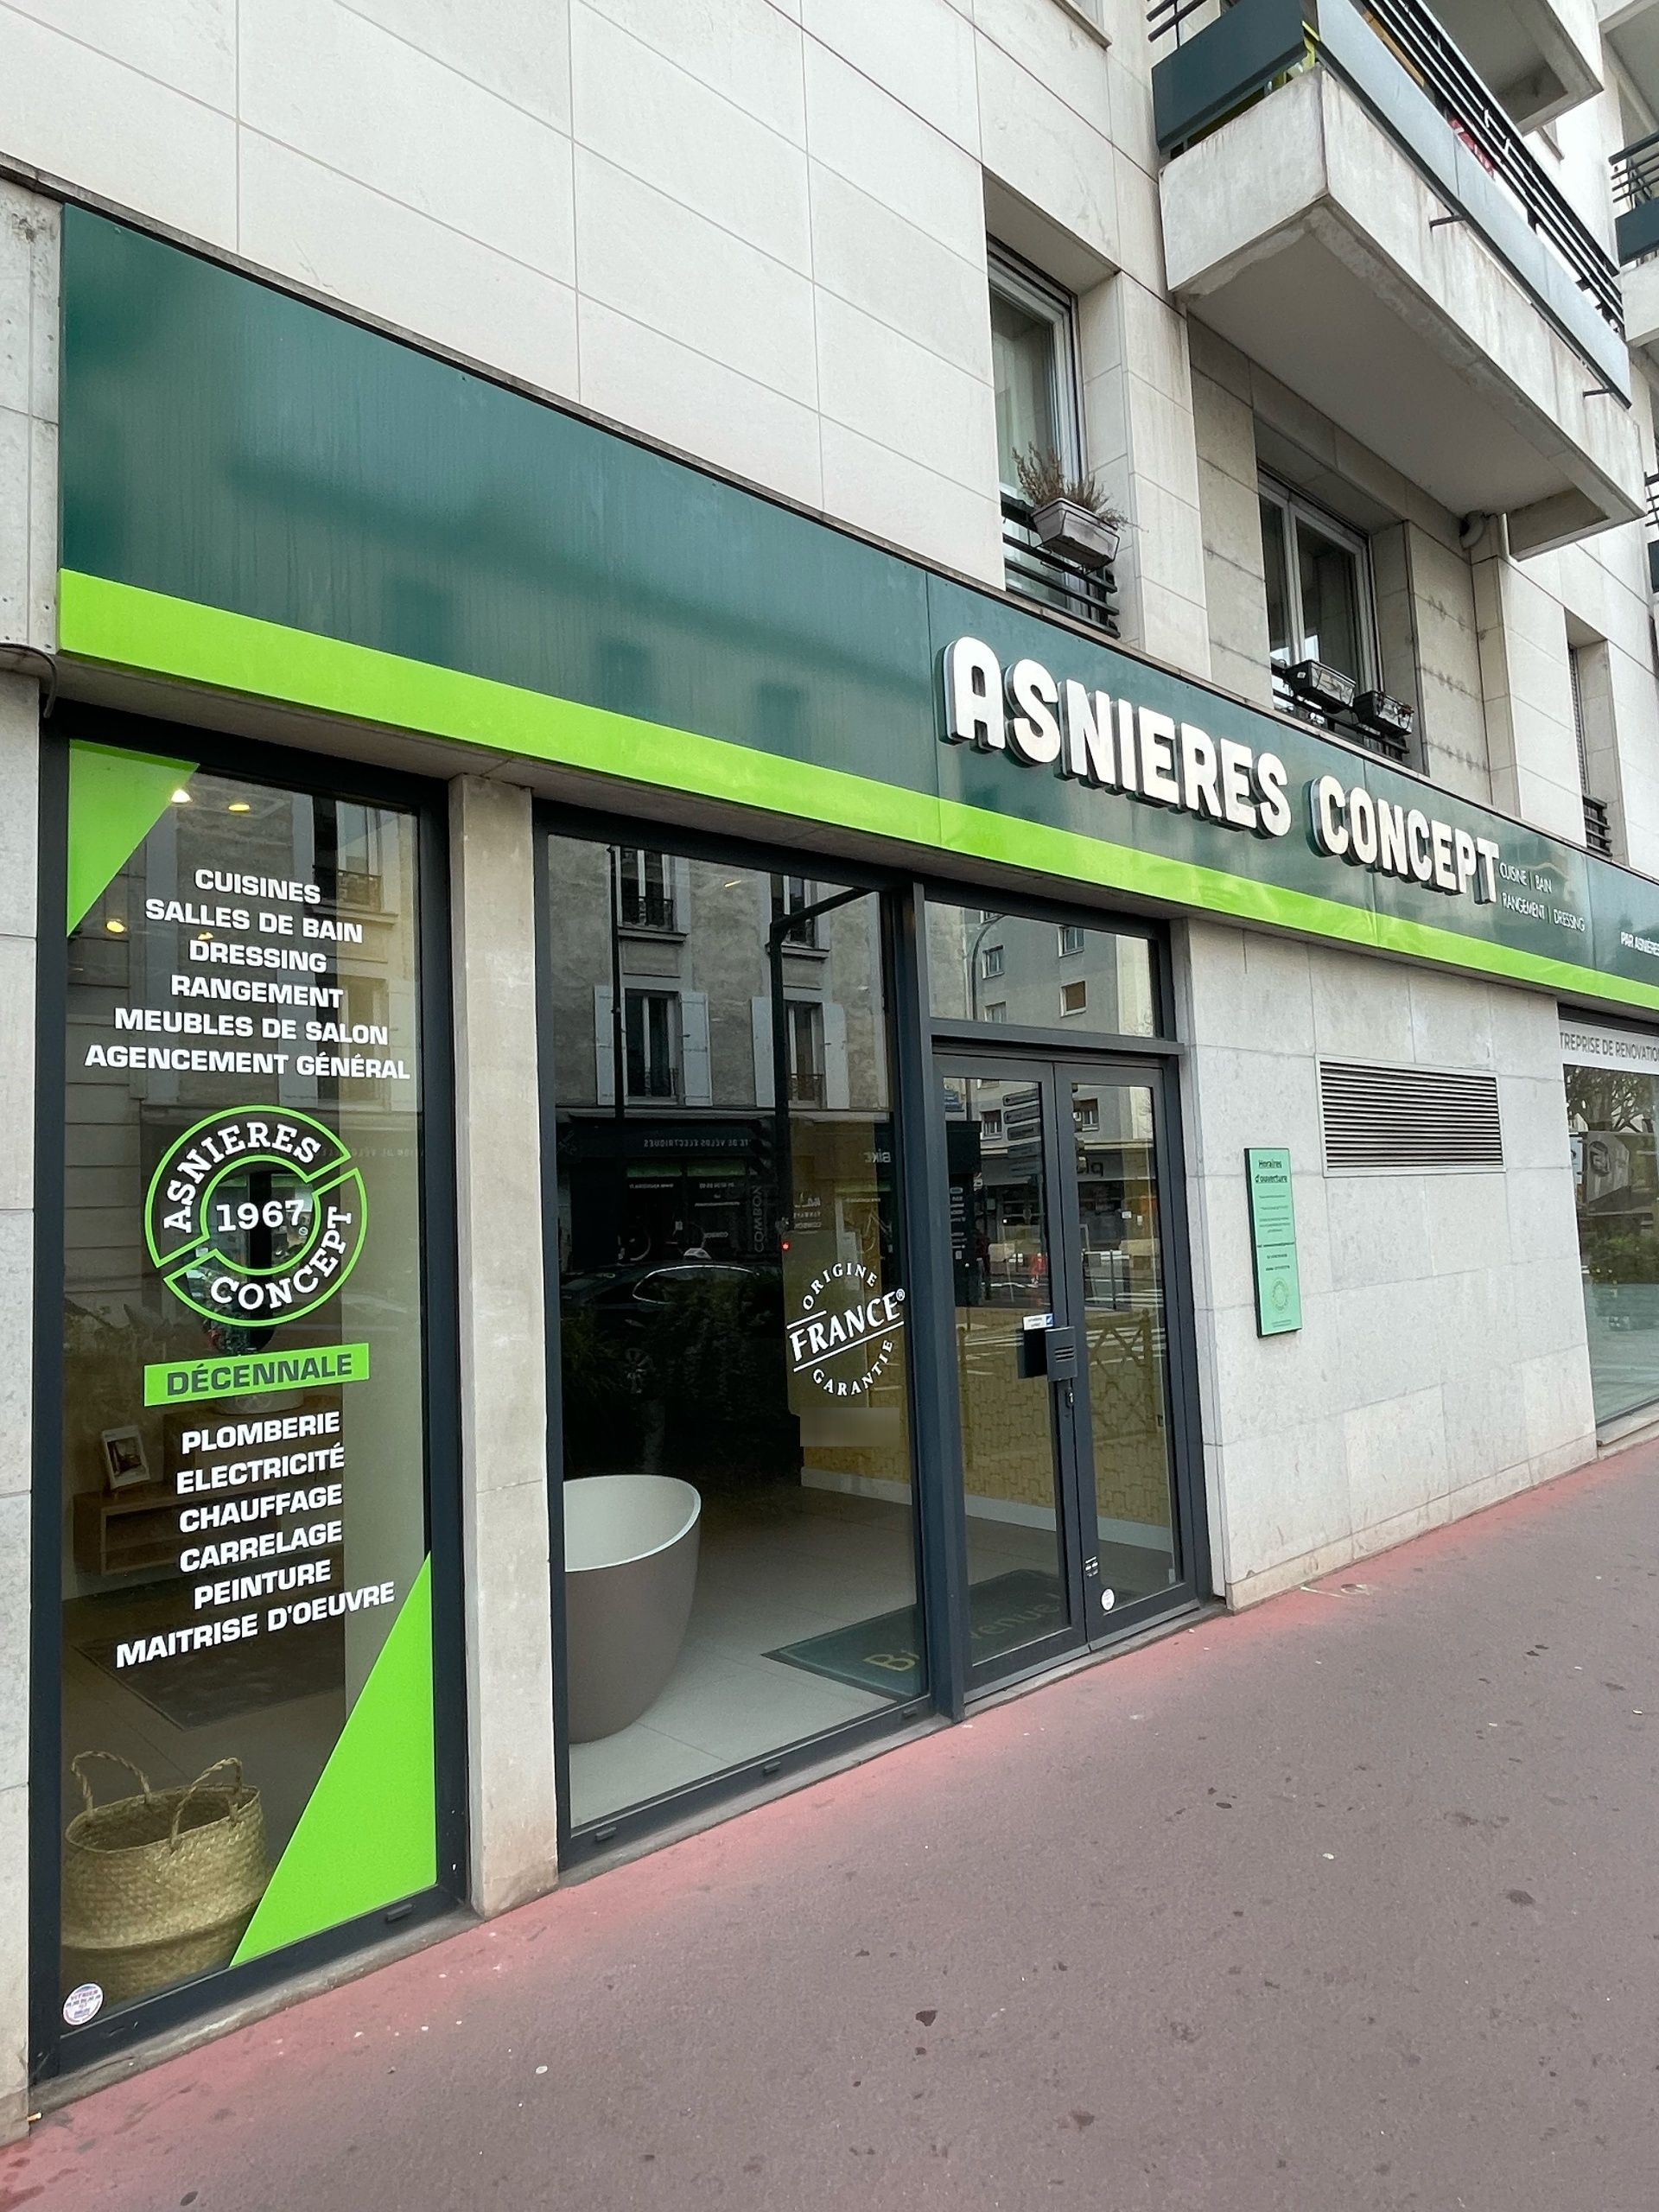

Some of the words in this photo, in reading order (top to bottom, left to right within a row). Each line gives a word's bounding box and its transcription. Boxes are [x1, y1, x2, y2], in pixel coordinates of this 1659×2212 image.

[945, 636, 1293, 837] ASNIERES
[1312, 775, 1500, 904] CONCEPT
[194, 868, 321, 905] CUISINES
[1499, 862, 1528, 886] CUISINE
[1535, 874, 1553, 894] BAIN
[145, 899, 251, 931] SALLES
[258, 912, 294, 936] DE
[302, 917, 364, 944] BAIN
[1502, 892, 1545, 920] RANGEMENT
[1554, 908, 1586, 931] DRESSING
[189, 939, 328, 974] DRESSING
[171, 974, 344, 1008] RANGEMENT
[114, 1007, 254, 1038] MEUBLES
[262, 1018, 297, 1040] DE
[305, 1020, 389, 1046] SALON
[1602, 1039, 1614, 1056] DE
[85, 1045, 289, 1076] AGENCEMENT
[296, 1051, 411, 1080] GÉNÉRAL
[163, 1122, 321, 1234] ASNIERES
[1258, 1159, 1282, 1169] Horaires
[215, 1199, 305, 1232] 1967
[210, 1206, 353, 1311] CONCEPT
[802, 1262, 878, 1312] ORIGINE
[167, 1353, 353, 1397] DÉCENNALE
[812, 1338, 894, 1397] GARANTIE
[181, 1411, 340, 1455] PLOMBERIE
[176, 1442, 346, 1496] ELECTRICITÉ
[179, 1484, 344, 1535] CHAUFFAGE
[179, 1521, 344, 1573] CARRELAGE
[194, 1559, 332, 1611] PEINTURE
[116, 1612, 259, 1669] MAITRISE
[267, 1581, 396, 1632] D'OEUVRE
